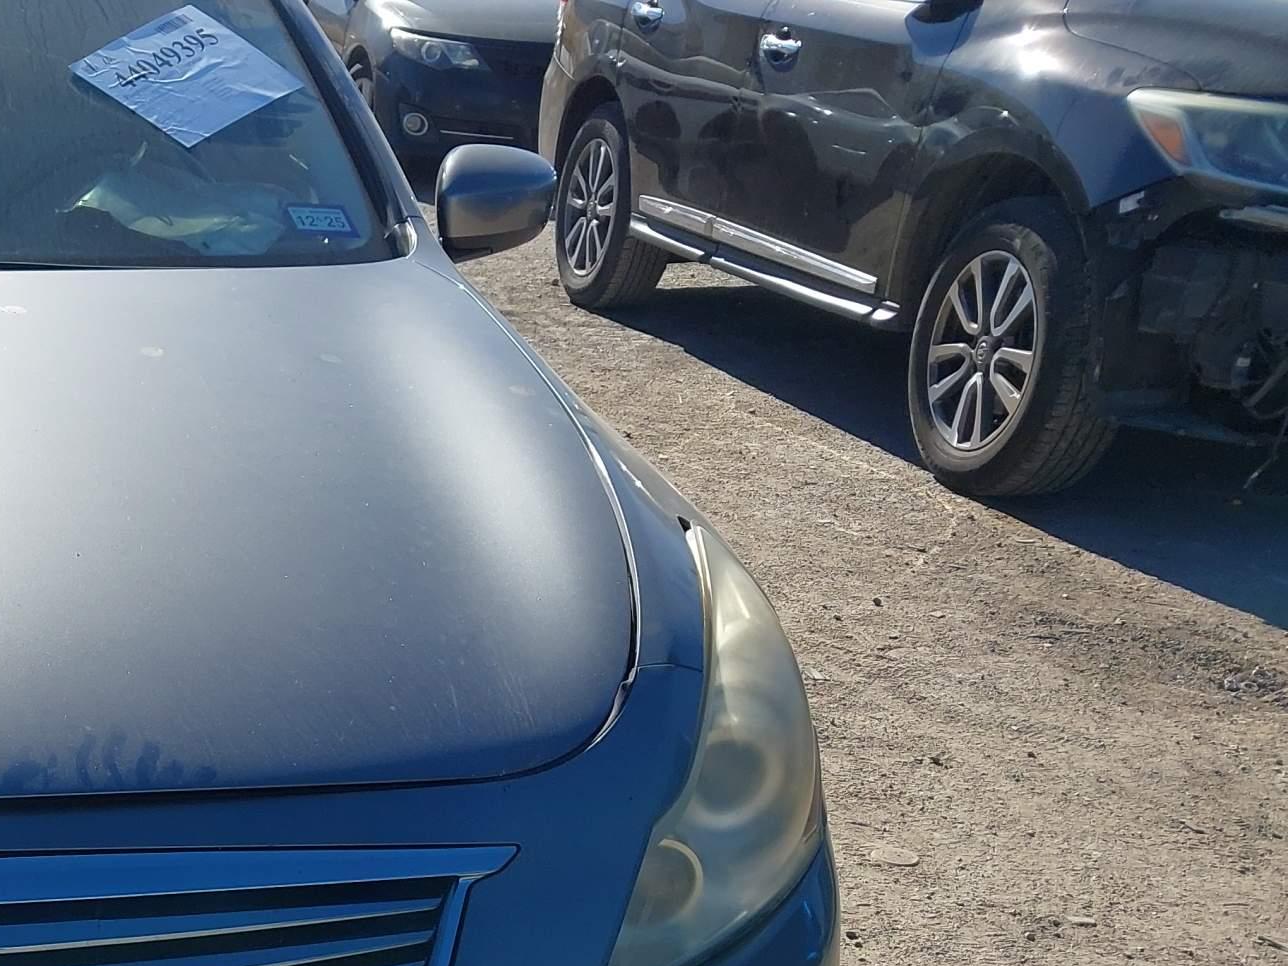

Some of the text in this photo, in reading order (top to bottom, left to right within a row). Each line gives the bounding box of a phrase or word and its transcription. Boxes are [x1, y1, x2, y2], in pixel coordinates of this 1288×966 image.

[115, 28, 219, 88] 44049395
[296, 215, 346, 229] 12 25
